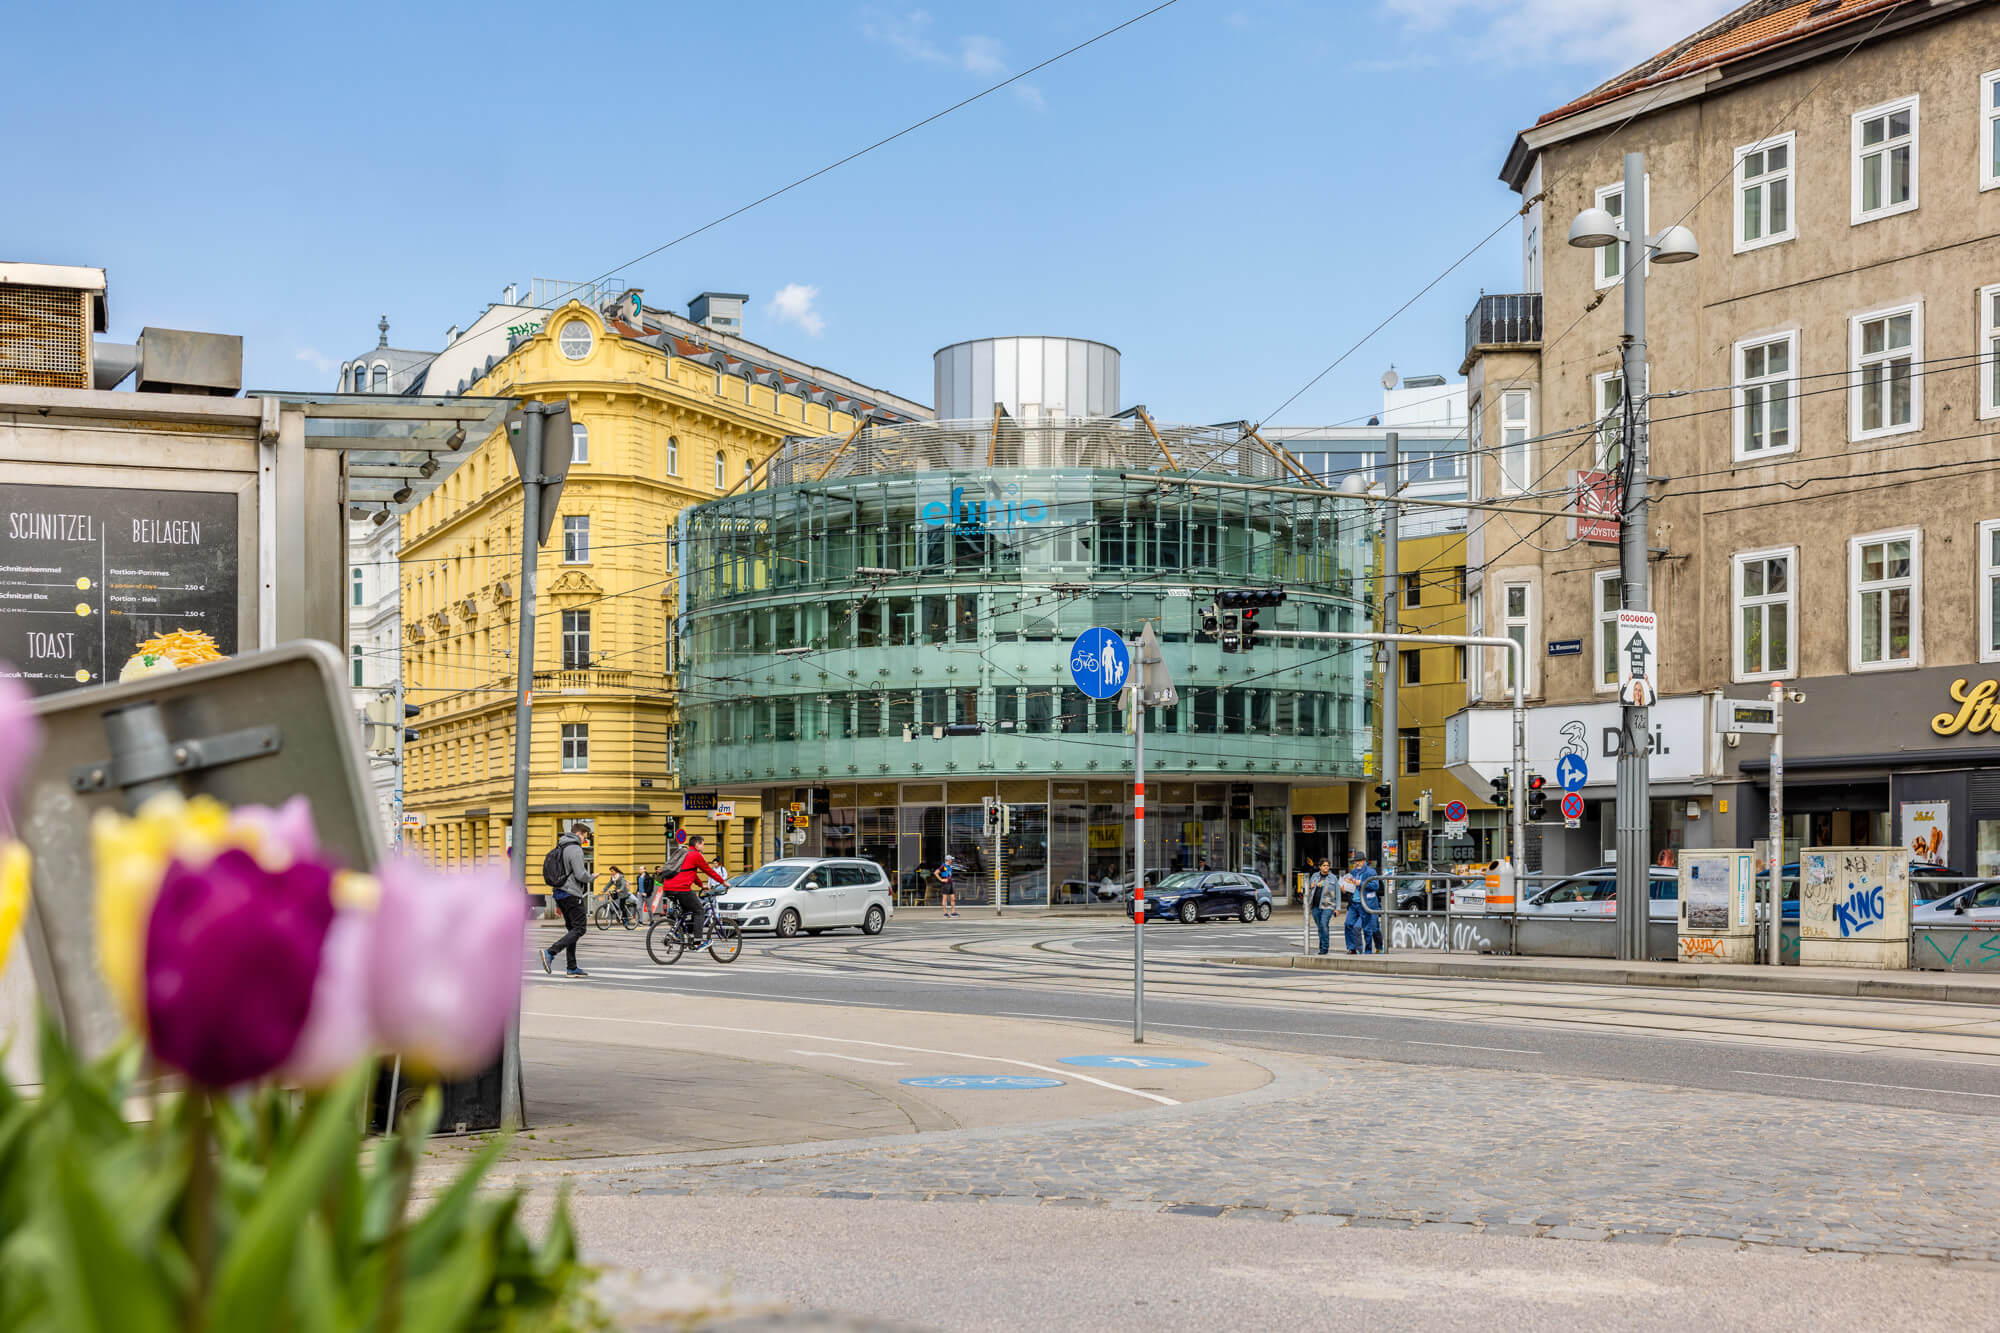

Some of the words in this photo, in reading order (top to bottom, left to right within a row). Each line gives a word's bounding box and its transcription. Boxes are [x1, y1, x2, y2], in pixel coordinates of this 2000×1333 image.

[9, 512, 96, 541] SCHNITZEL
[26, 632, 75, 659] TOAST
[718, 803, 731, 813] dm
[404, 814, 418, 822] dm
